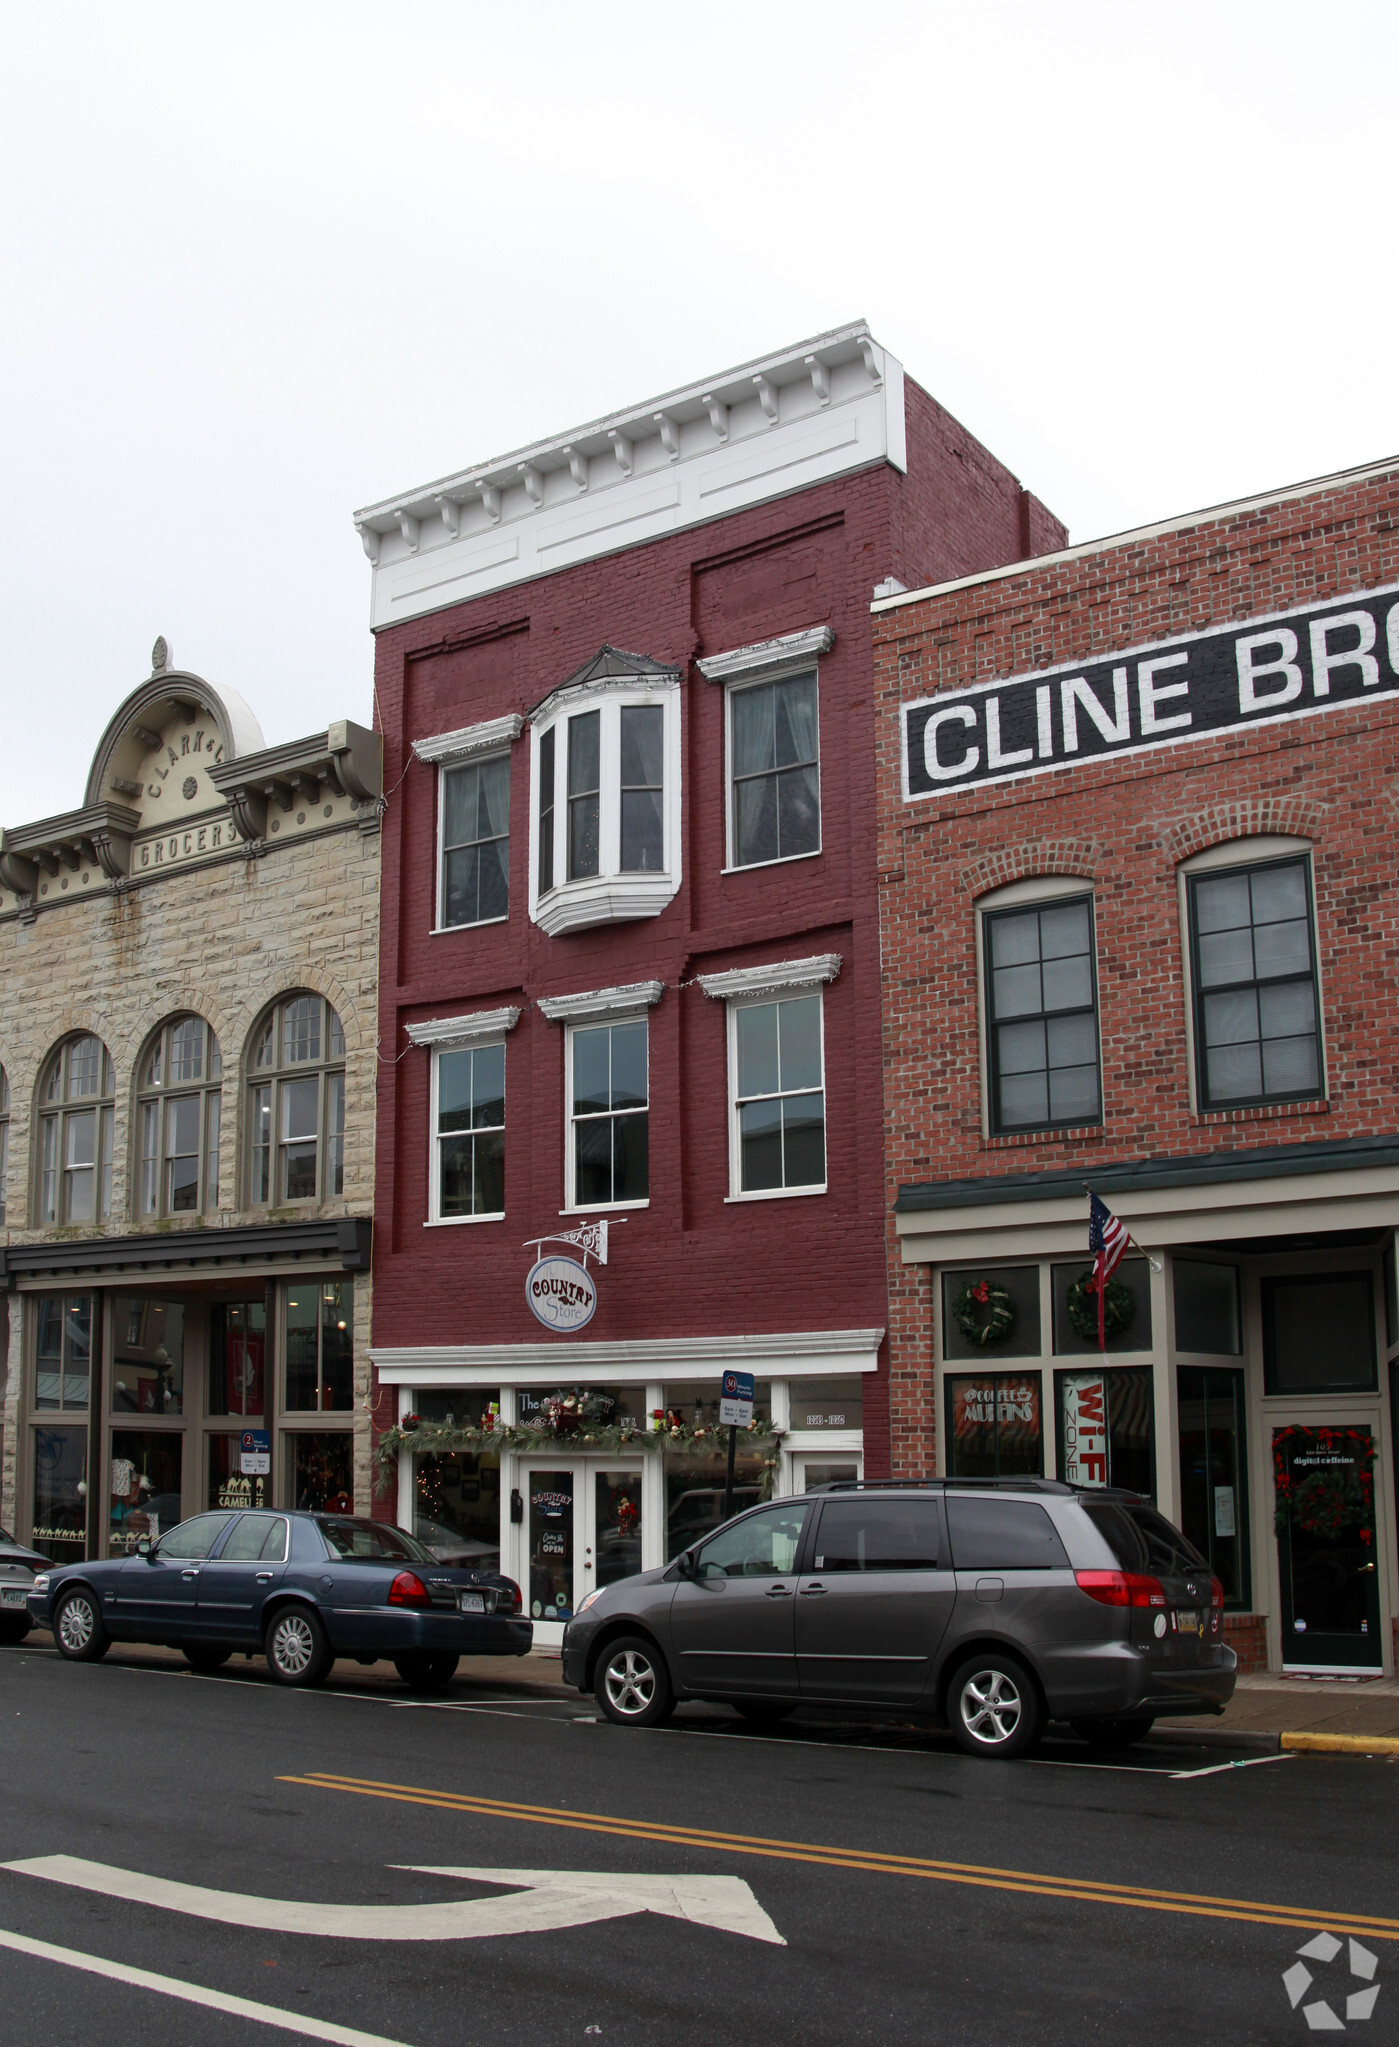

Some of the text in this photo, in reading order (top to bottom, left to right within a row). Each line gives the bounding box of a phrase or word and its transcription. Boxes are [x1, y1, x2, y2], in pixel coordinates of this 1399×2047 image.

[923, 601, 1399, 782] CLINE BR
[147, 730, 205, 798] CLARK
[140, 820, 237, 866] GROCERS
[544, 1265, 556, 1278] The
[532, 1278, 593, 1308] COUNTRY
[543, 1295, 582, 1322] Store
[727, 1379, 736, 1388] 30
[518, 1393, 540, 1412] The
[245, 1435, 252, 1445] 2
[1078, 1383, 1106, 1483] Wi-F
[1066, 1408, 1078, 1480] ZONE
[1293, 1456, 1355, 1467] digital caffeine
[531, 1491, 572, 1506] COUNTRY
[537, 1502, 564, 1517] Store
[543, 1544, 564, 1554] OPEN
